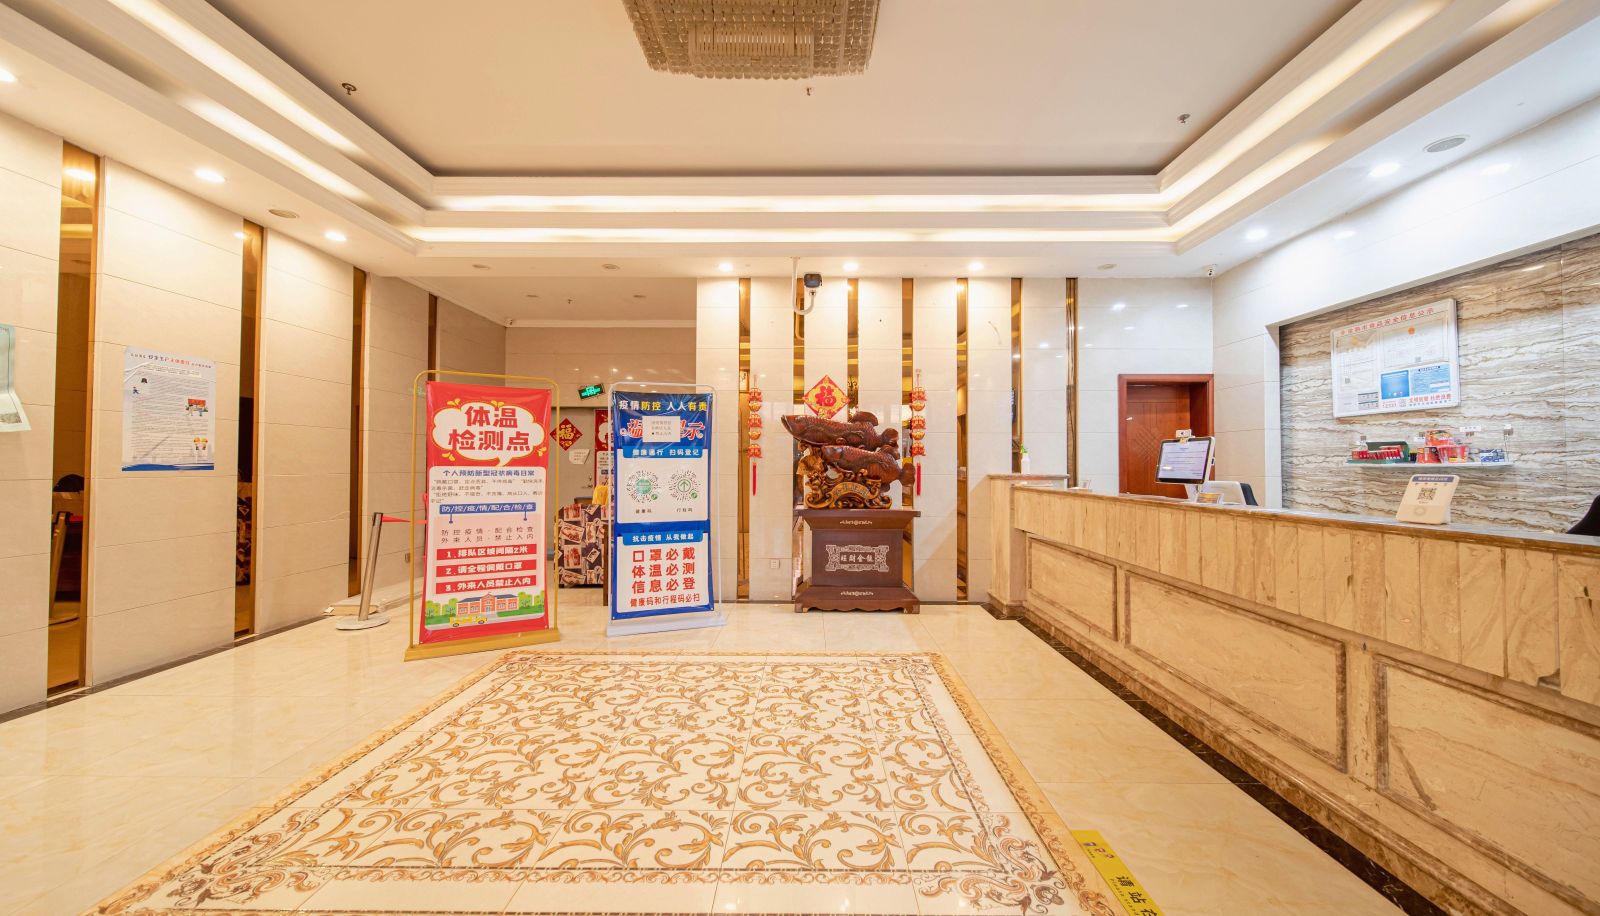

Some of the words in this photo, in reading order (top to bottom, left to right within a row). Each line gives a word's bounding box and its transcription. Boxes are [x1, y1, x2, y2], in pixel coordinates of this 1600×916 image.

[815, 385, 837, 407] 福
[619, 400, 661, 411] 疫情防控
[667, 401, 707, 411] 人人有责
[465, 406, 518, 428] 体温
[448, 429, 530, 451] 检测点
[632, 547, 695, 562] 口罩必戴
[632, 562, 695, 578] 体温必测
[632, 577, 695, 594] 信息必登
[631, 593, 700, 607] 健康码和行程码必扫
